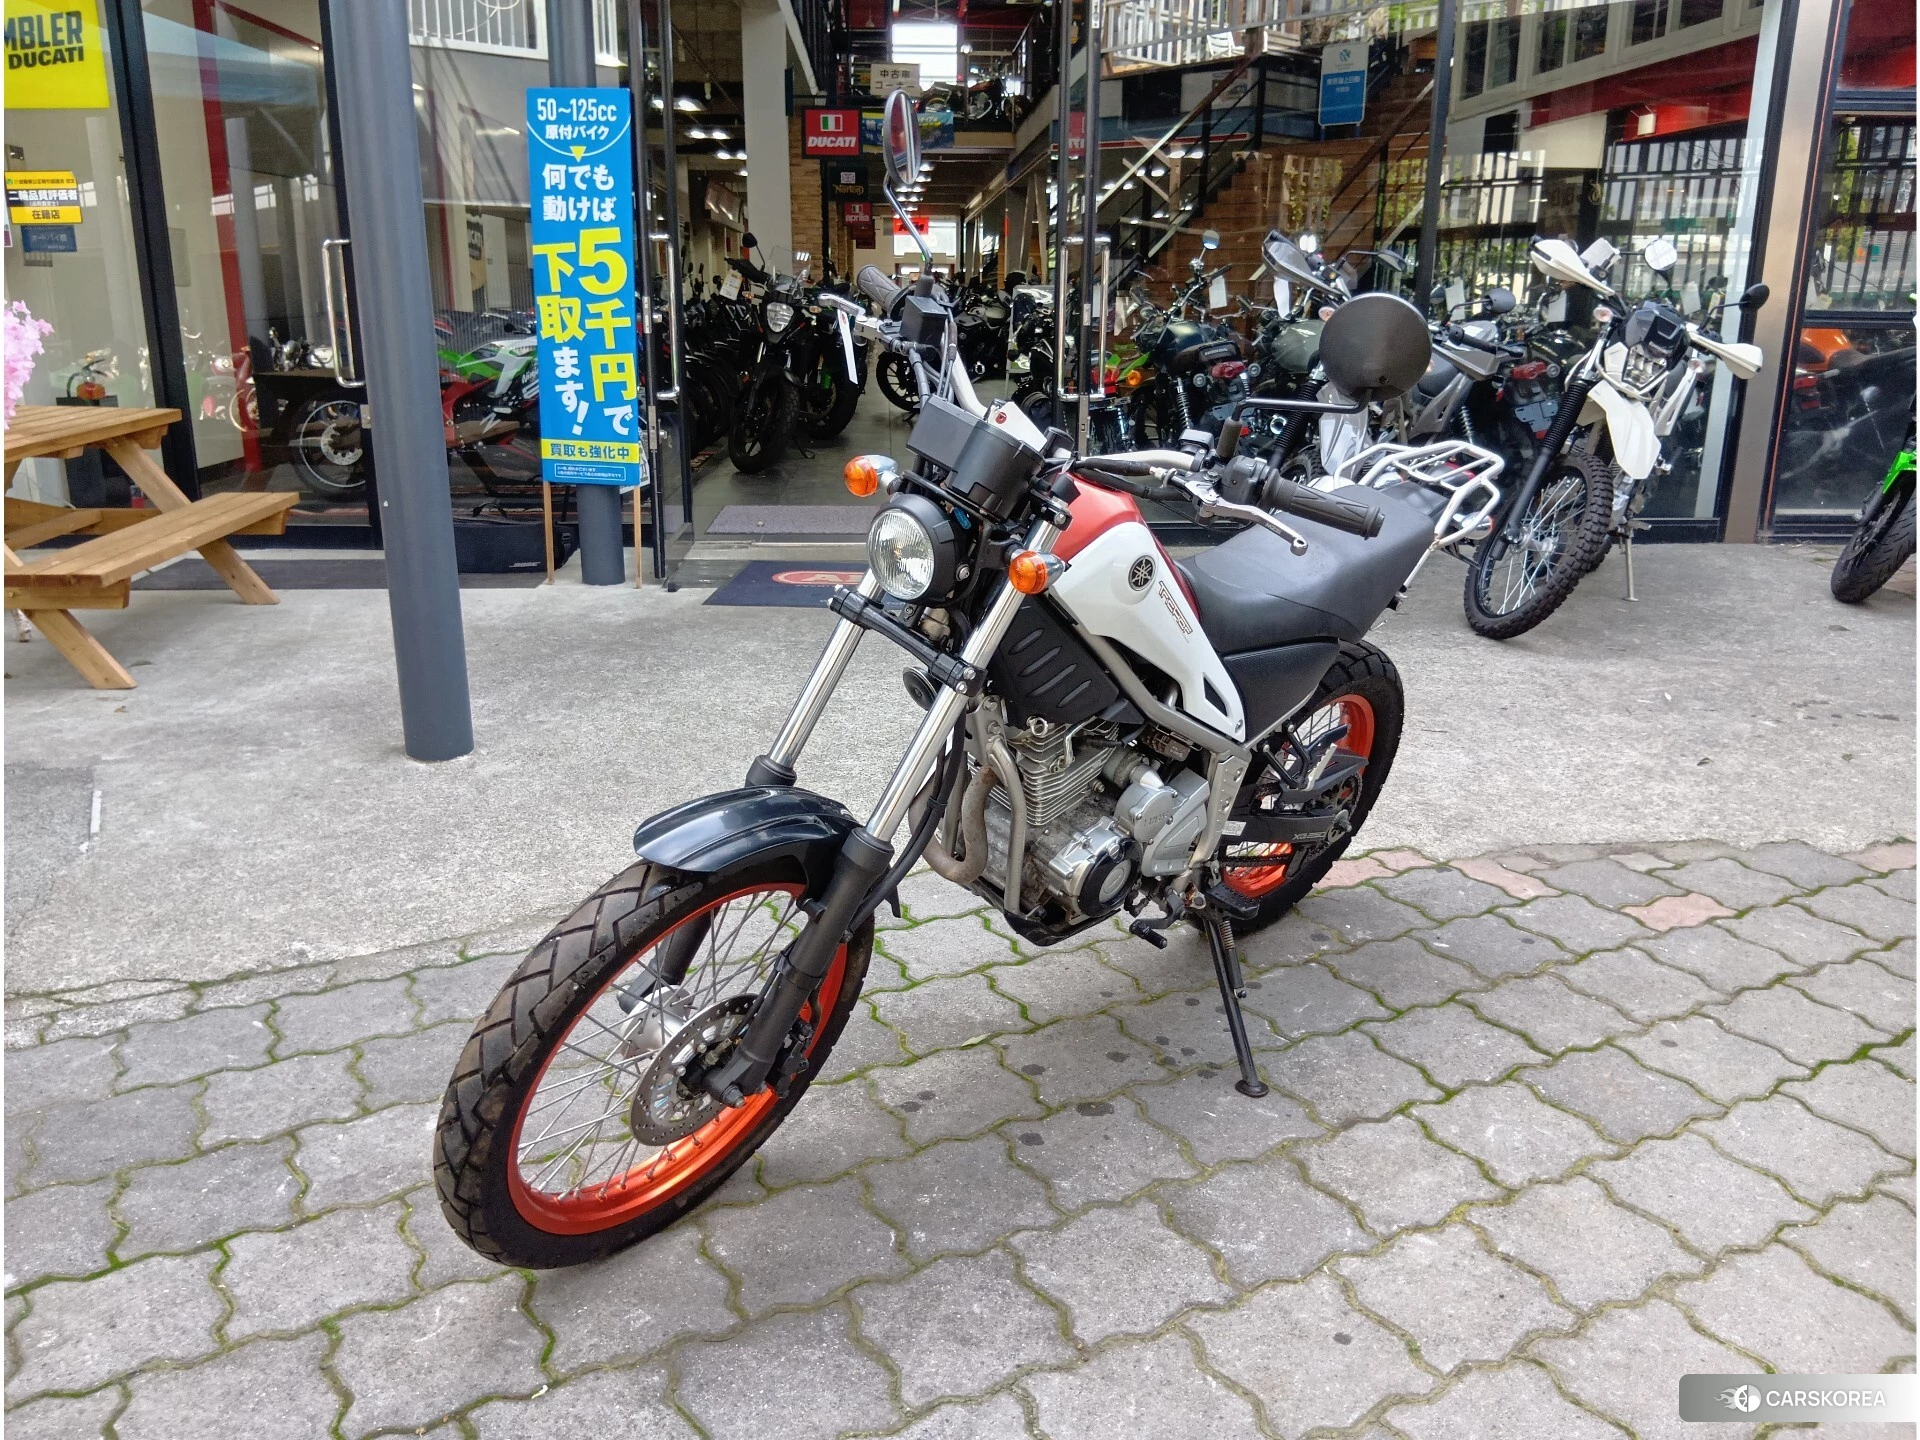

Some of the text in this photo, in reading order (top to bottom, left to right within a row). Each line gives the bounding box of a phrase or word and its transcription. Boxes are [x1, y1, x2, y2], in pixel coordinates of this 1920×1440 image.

[8, 45, 85, 70] DUCATI
[545, 124, 610, 141] 原付バイク
[807, 135, 857, 149] DUCATI
[541, 163, 615, 191] 何でも
[832, 183, 865, 196] Norton
[31, 209, 61, 220] 在籍店
[542, 196, 617, 222] 動けば
[845, 213, 870, 223] aprilia
[550, 443, 630, 460] 買取も強化中
